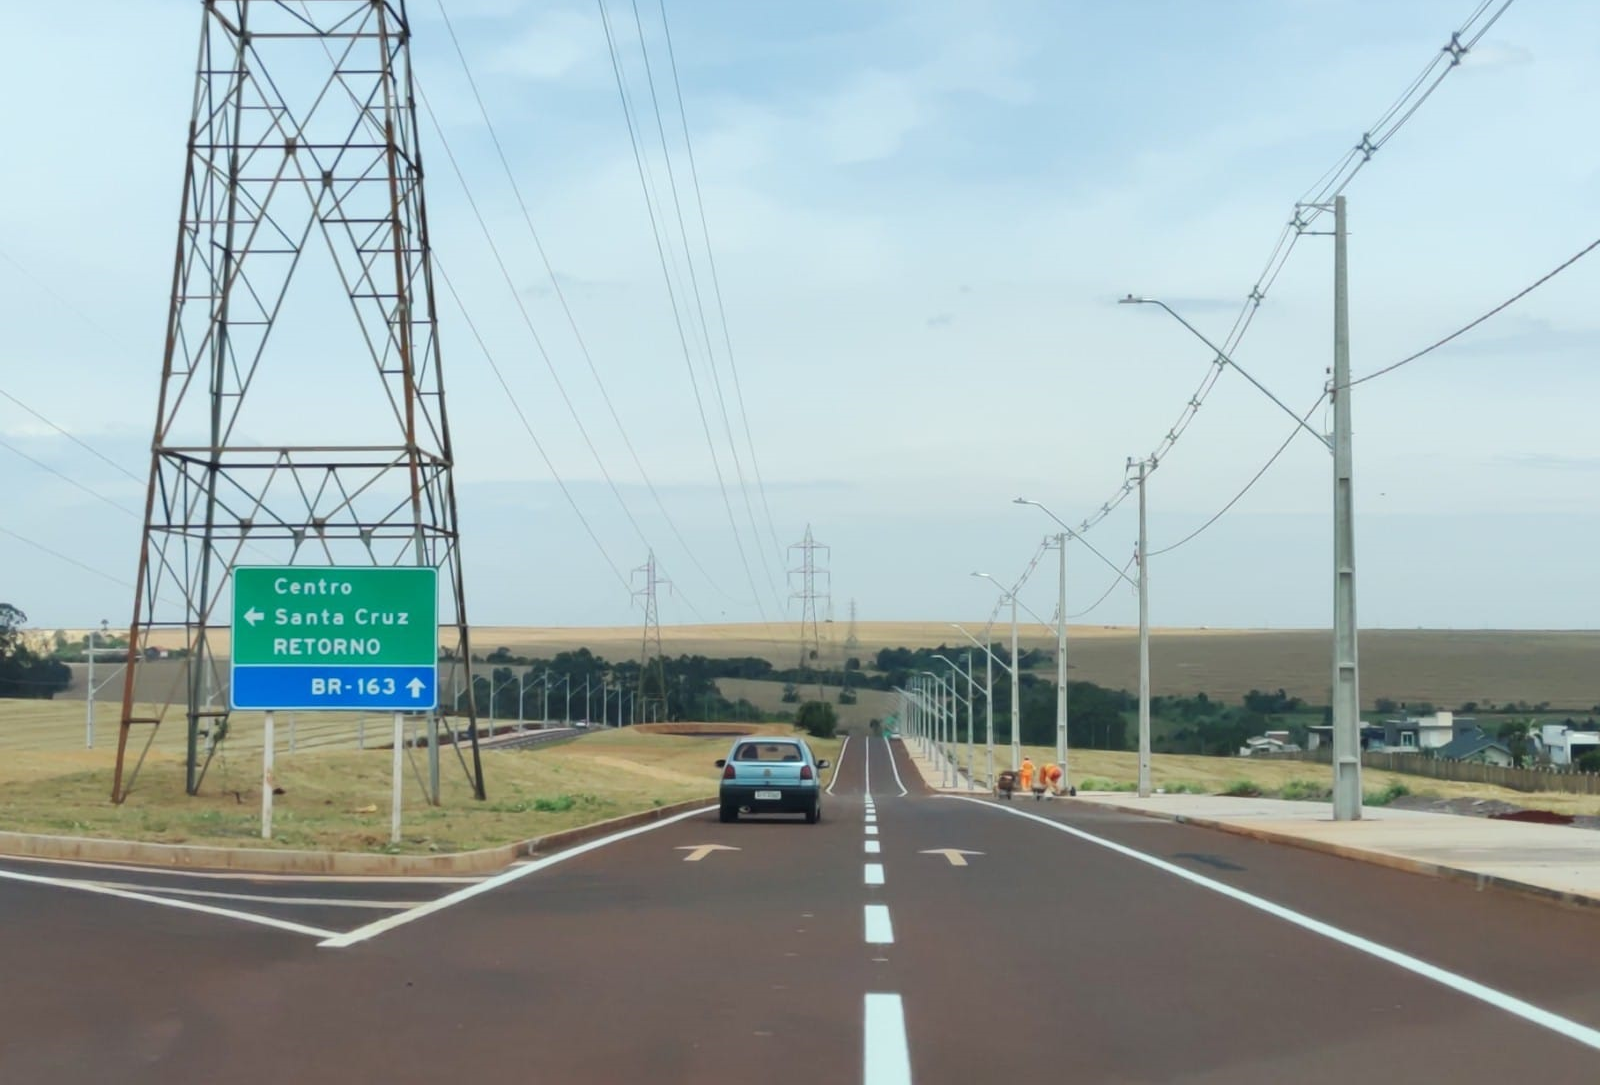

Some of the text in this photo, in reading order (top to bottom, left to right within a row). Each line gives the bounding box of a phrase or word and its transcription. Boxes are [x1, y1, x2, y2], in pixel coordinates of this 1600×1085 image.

[274, 577, 352, 595] Centro
[275, 608, 409, 626] Santa Cruz
[273, 637, 381, 655] RETORNO
[311, 677, 396, 695] BR-163
